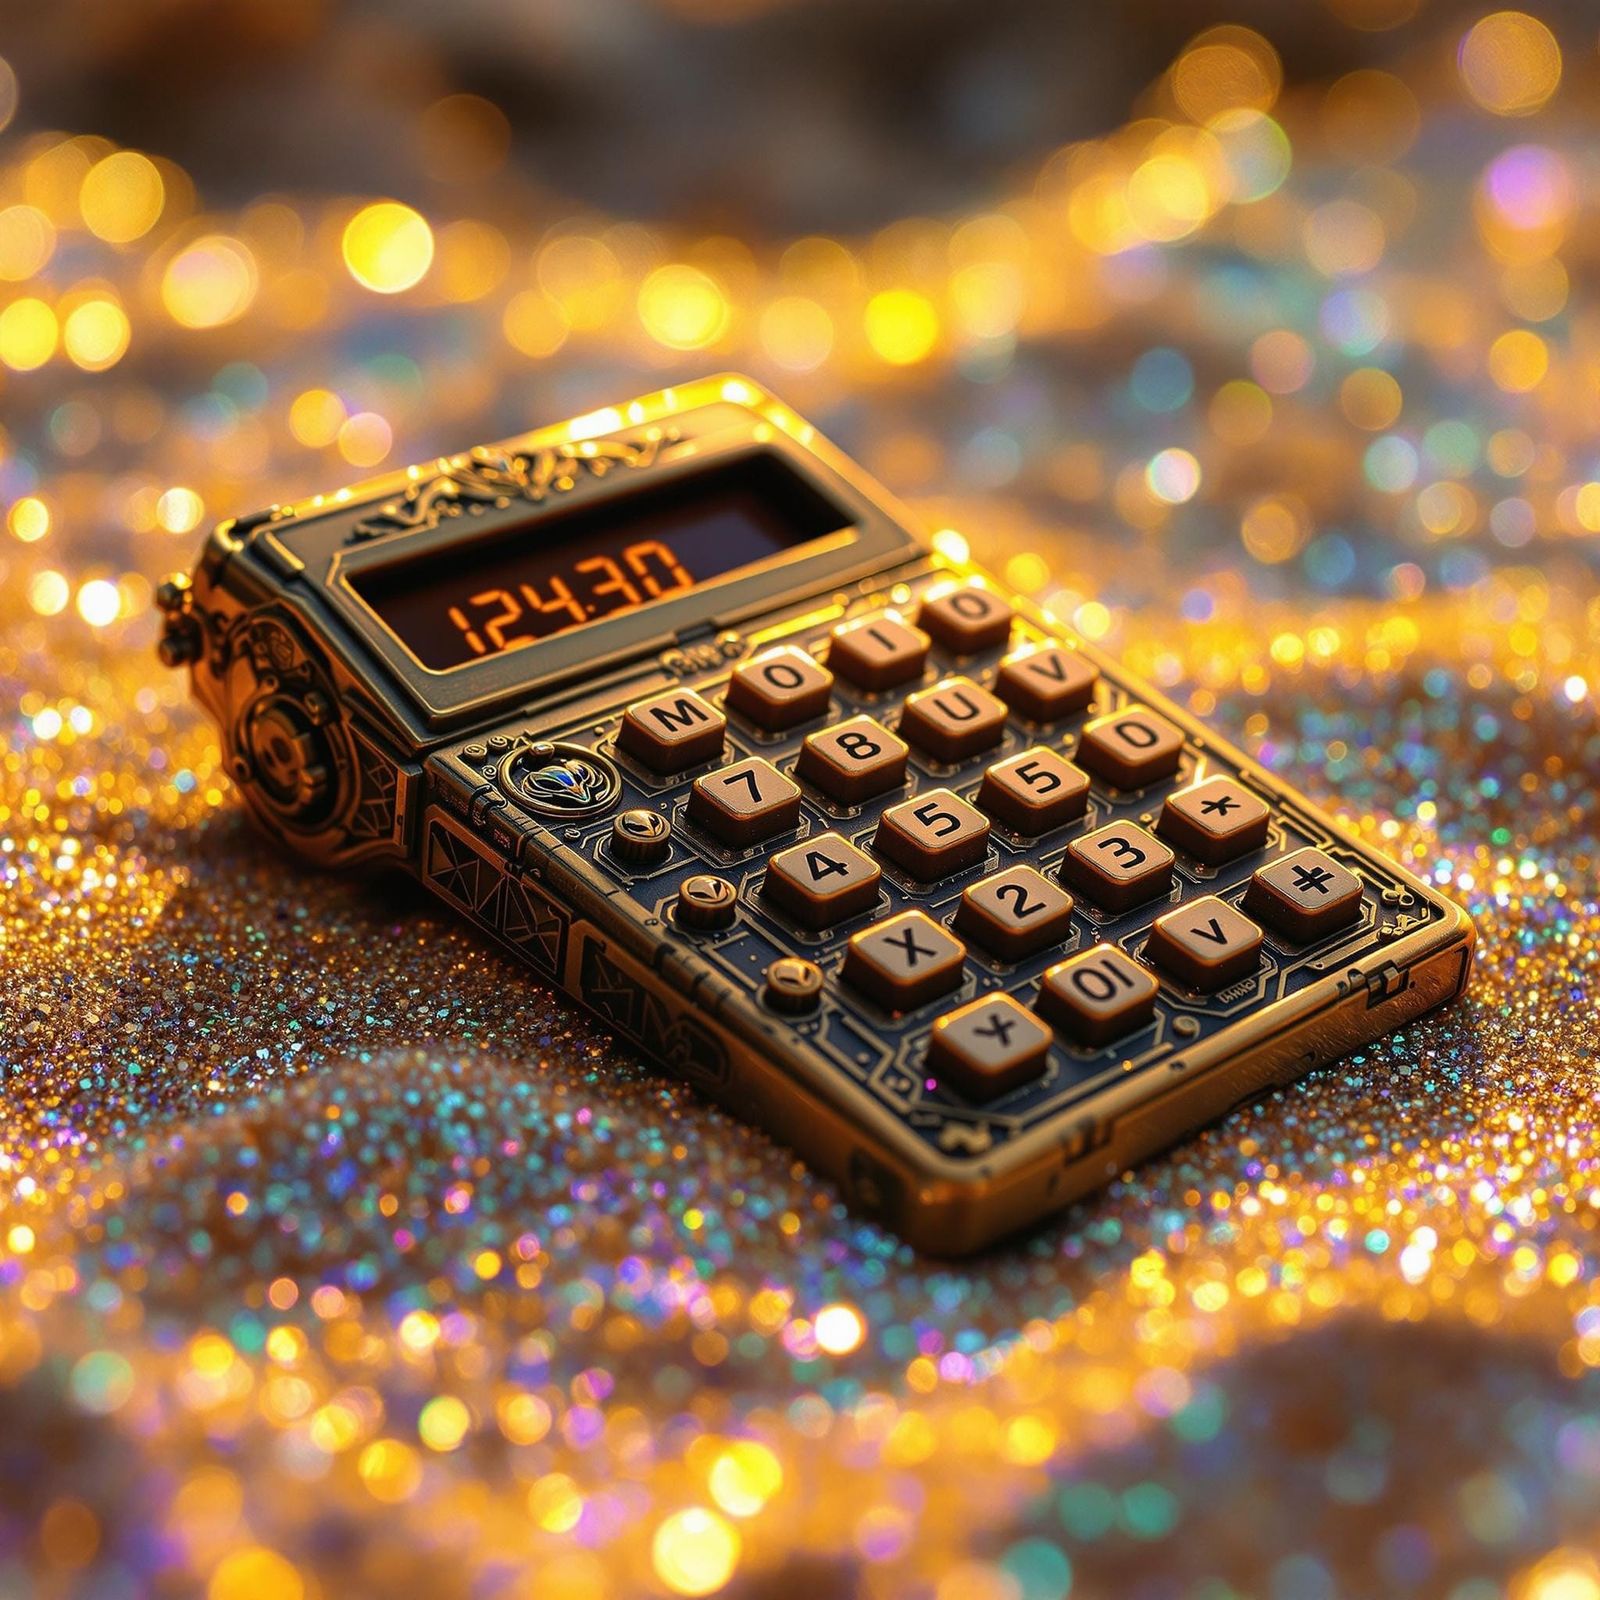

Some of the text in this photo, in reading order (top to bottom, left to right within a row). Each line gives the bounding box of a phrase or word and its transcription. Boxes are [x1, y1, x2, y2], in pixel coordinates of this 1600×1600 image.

[448, 540, 694, 655] 124.30
[648, 698, 709, 733] M
[932, 692, 980, 722] U
[835, 732, 882, 760] 8
[723, 769, 763, 805] 7
[1013, 761, 1062, 796] 5
[912, 802, 961, 839] 5
[805, 850, 849, 882] 4
[1098, 837, 1146, 870] 3
[995, 884, 1047, 920] 2
